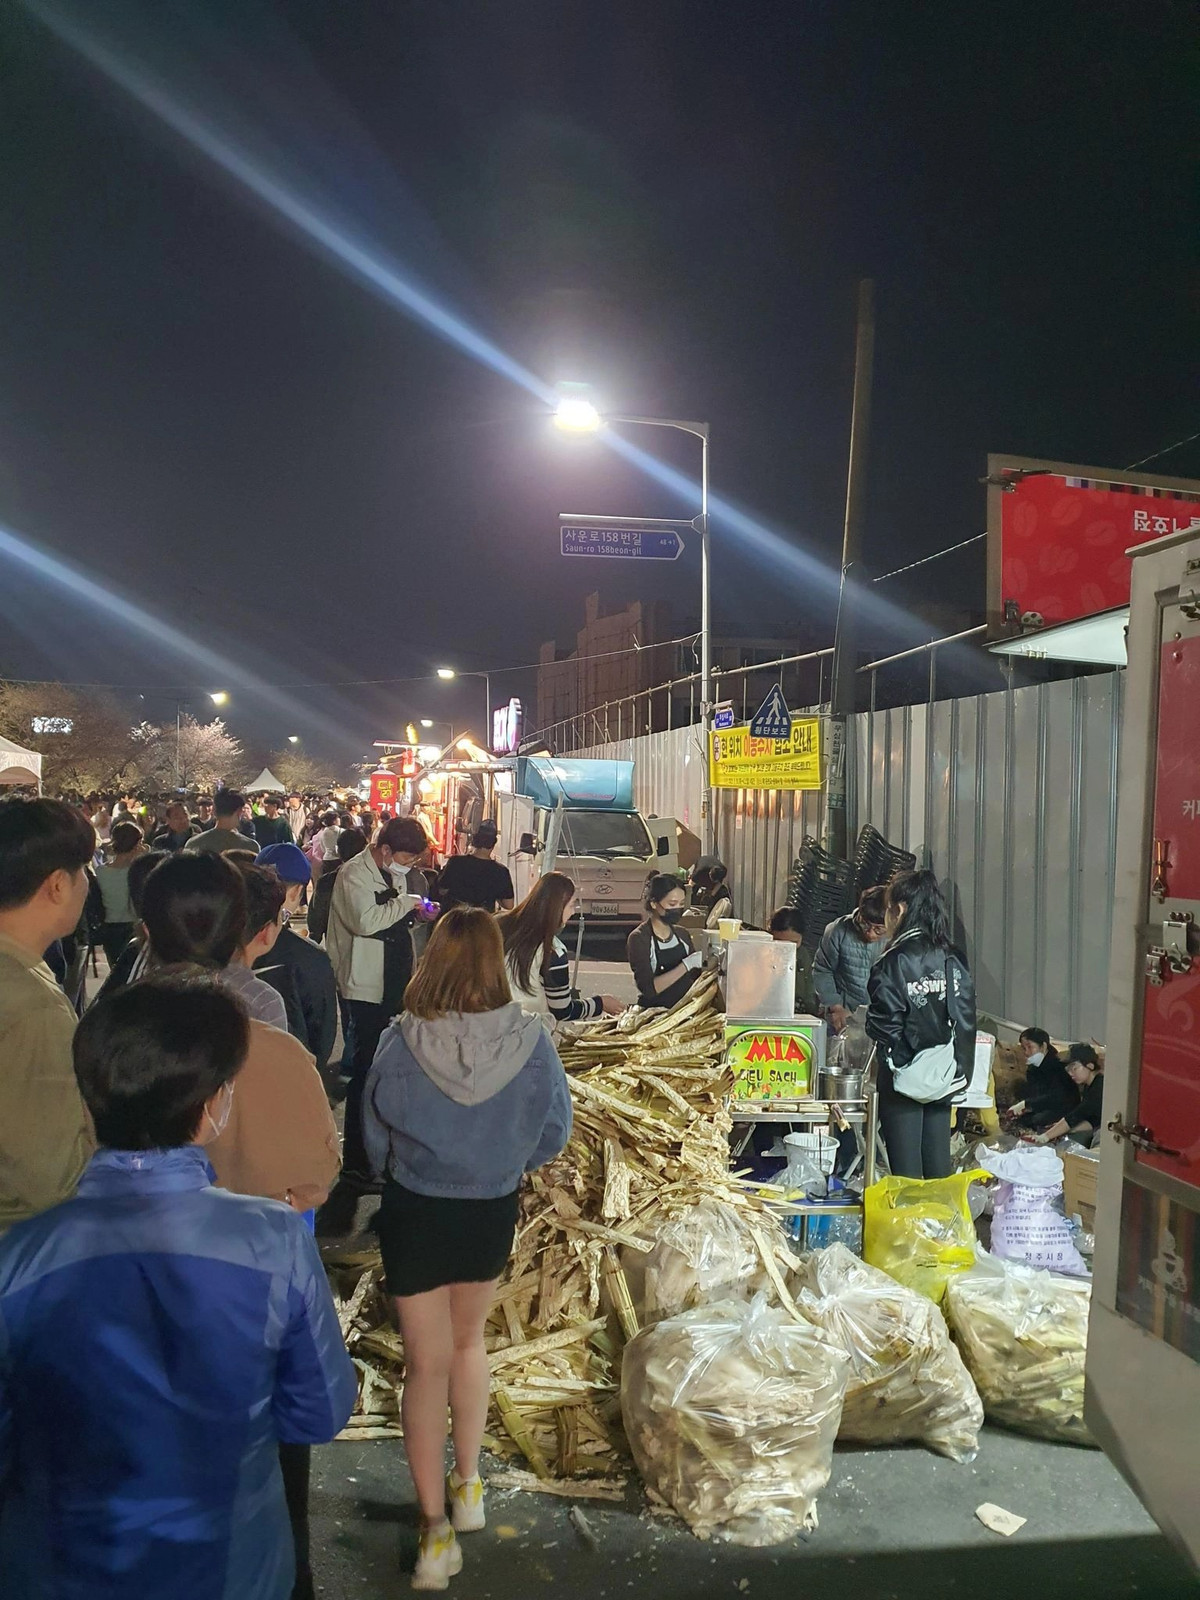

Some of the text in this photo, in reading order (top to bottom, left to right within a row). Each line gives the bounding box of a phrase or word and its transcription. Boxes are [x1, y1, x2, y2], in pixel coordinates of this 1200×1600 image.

[565, 544, 595, 553] Saun-ro
[754, 726, 788, 735] 횡단보도
[793, 725, 812, 754] 안내
